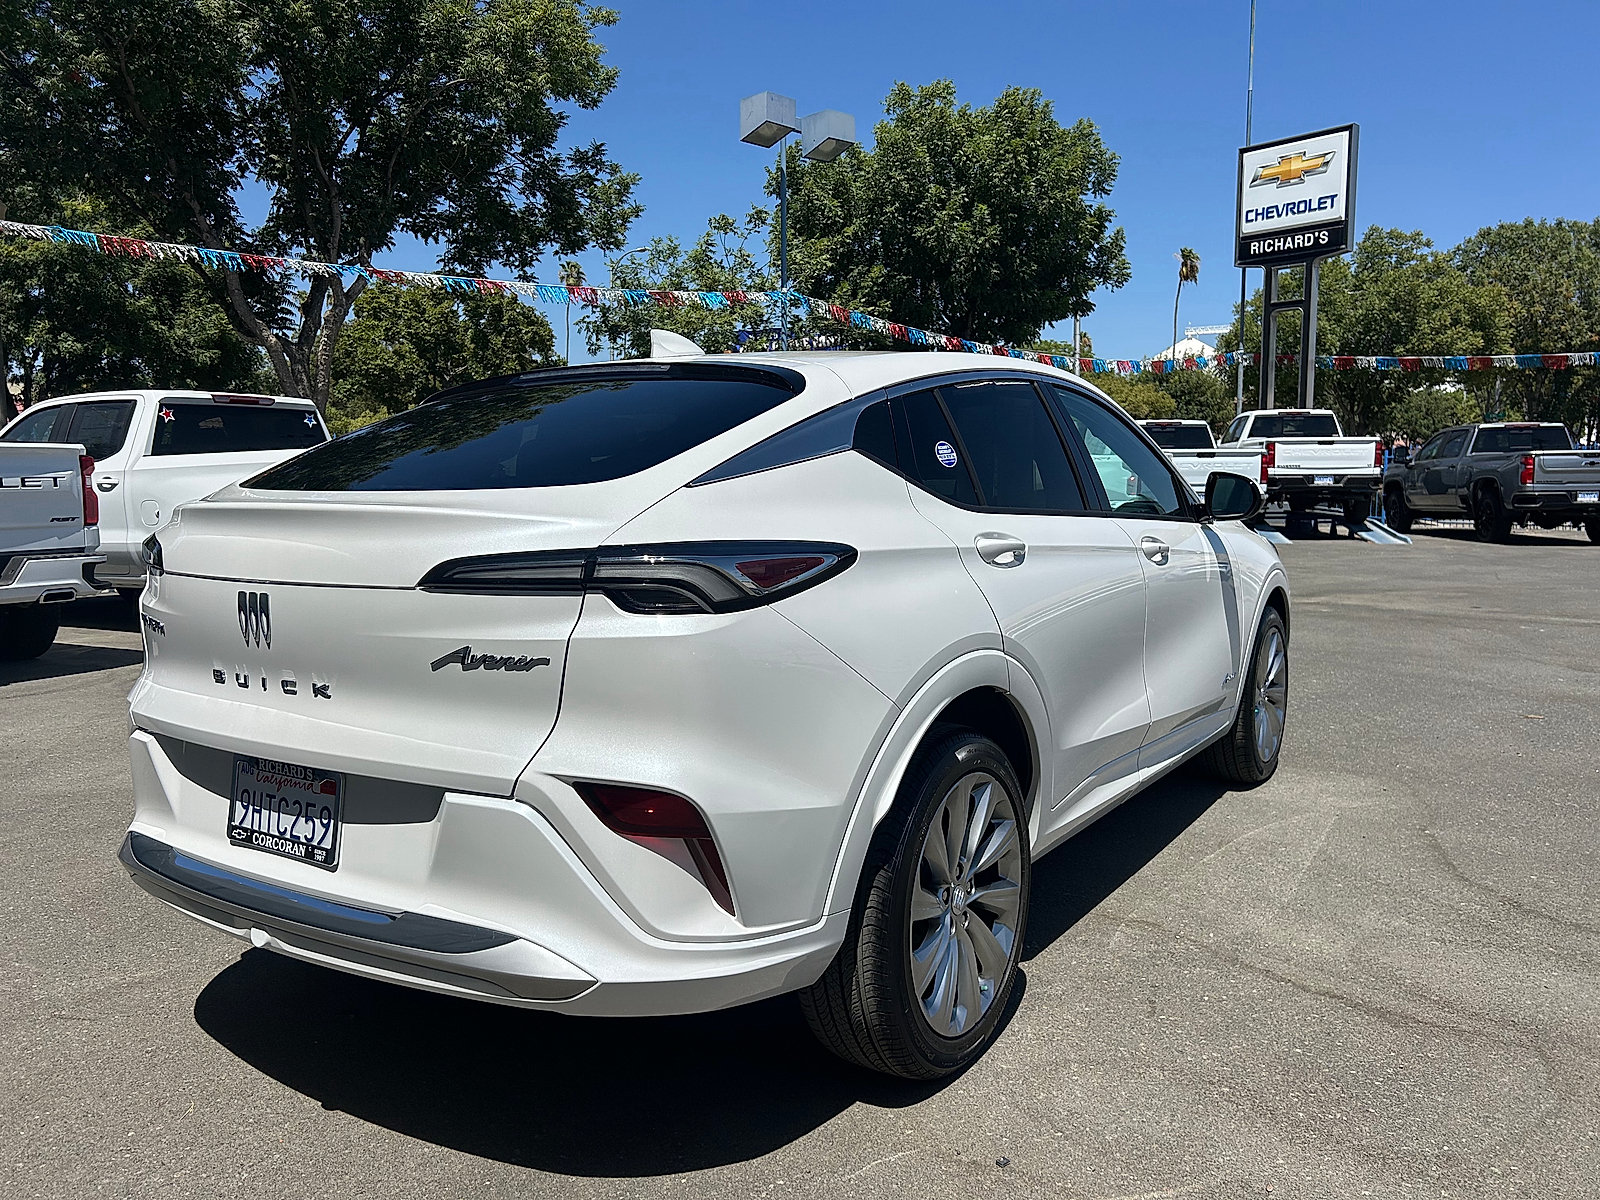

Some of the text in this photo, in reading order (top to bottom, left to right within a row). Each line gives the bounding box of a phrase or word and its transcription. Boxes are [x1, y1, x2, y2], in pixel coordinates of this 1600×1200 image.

[1245, 193, 1338, 224] CHEVROLET
[1250, 231, 1329, 255] RICHARD'S
[0, 476, 66, 489] LET
[430, 645, 551, 673] Avenir
[212, 668, 332, 700] BUICK
[255, 770, 321, 795] California
[238, 788, 332, 846] 9HTC259
[252, 832, 307, 858] CORCORAN
